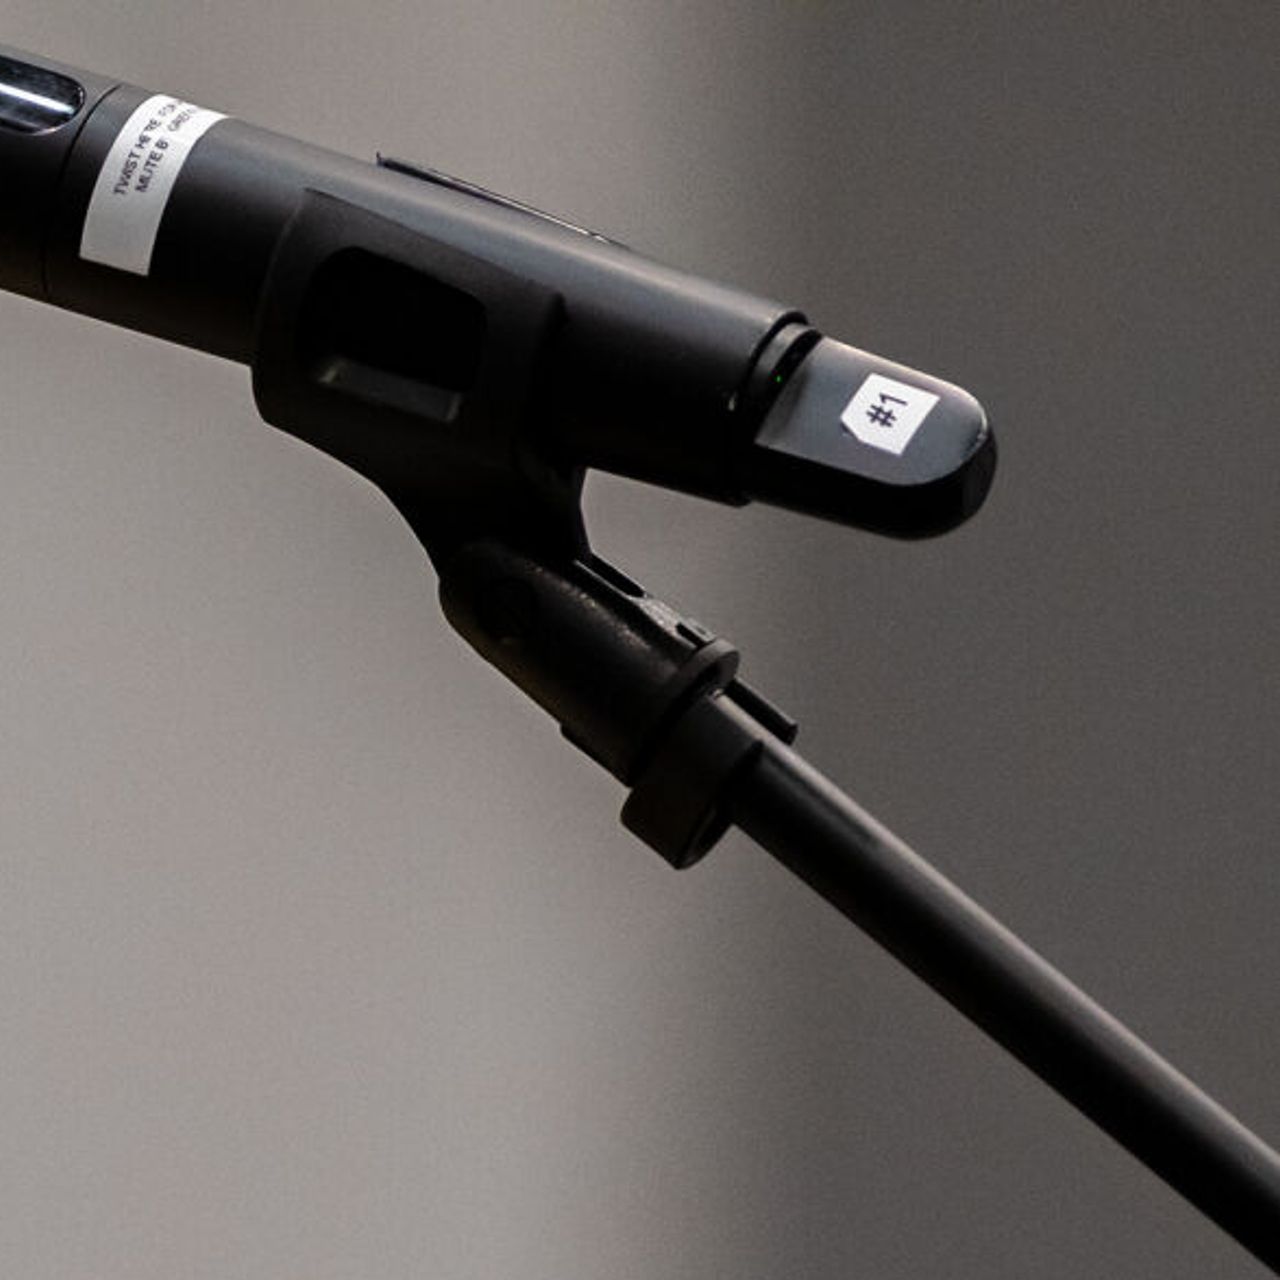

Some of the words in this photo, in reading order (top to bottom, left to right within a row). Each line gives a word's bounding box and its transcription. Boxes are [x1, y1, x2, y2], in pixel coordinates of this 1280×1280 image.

[113, 150, 141, 195] TWIST
[135, 150, 164, 193] MUTE
[866, 392, 909, 428] #1
